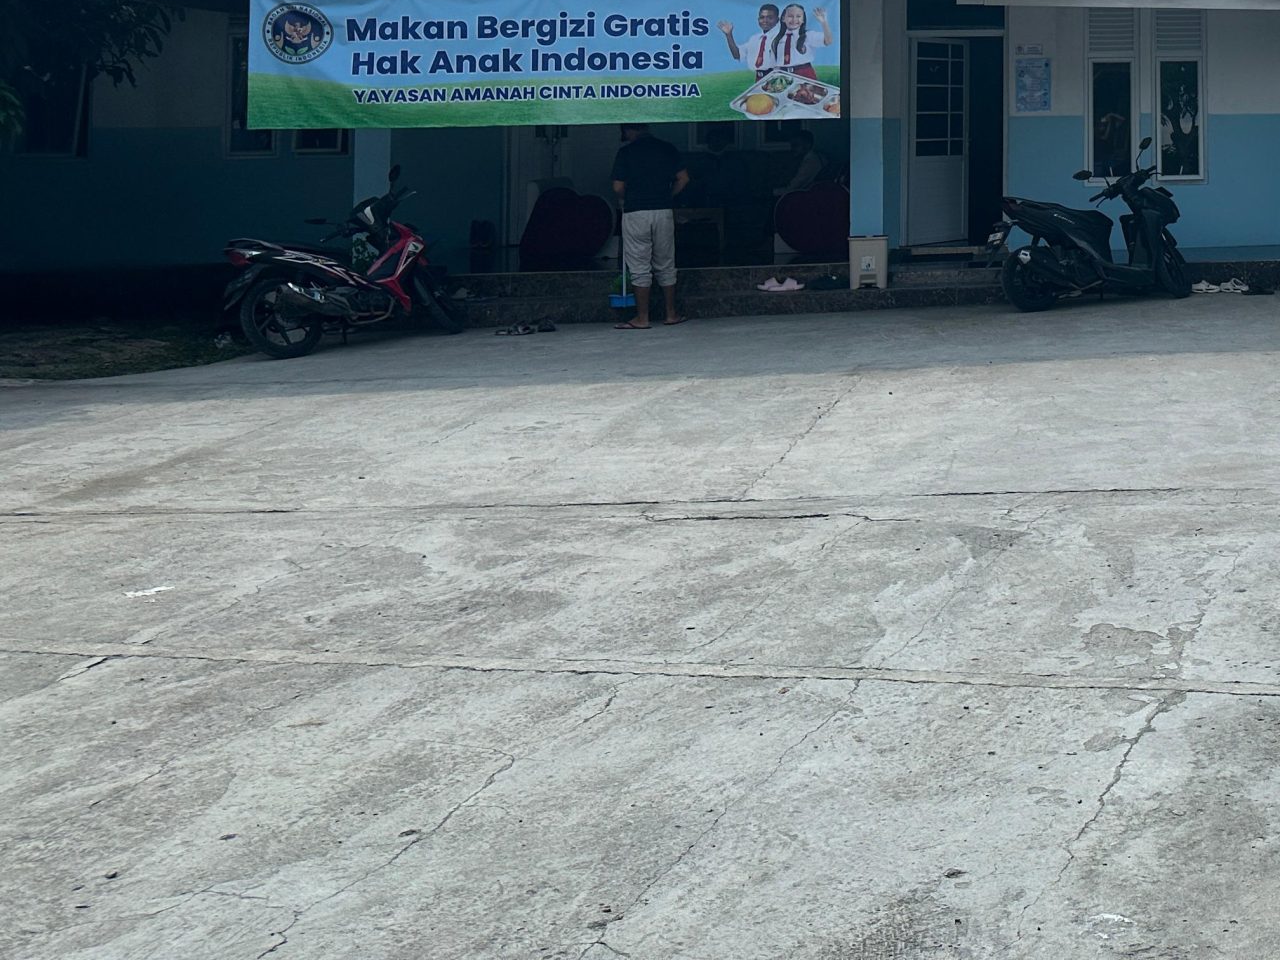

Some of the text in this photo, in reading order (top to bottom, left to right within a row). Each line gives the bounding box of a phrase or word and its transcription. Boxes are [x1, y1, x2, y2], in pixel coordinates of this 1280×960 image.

[346, 10, 709, 45] Makan Bergizi Gratis
[352, 44, 703, 75] Hak Anak Indonesia
[354, 84, 701, 102] YAYASAN AMANAH CINTA INDONESIA
